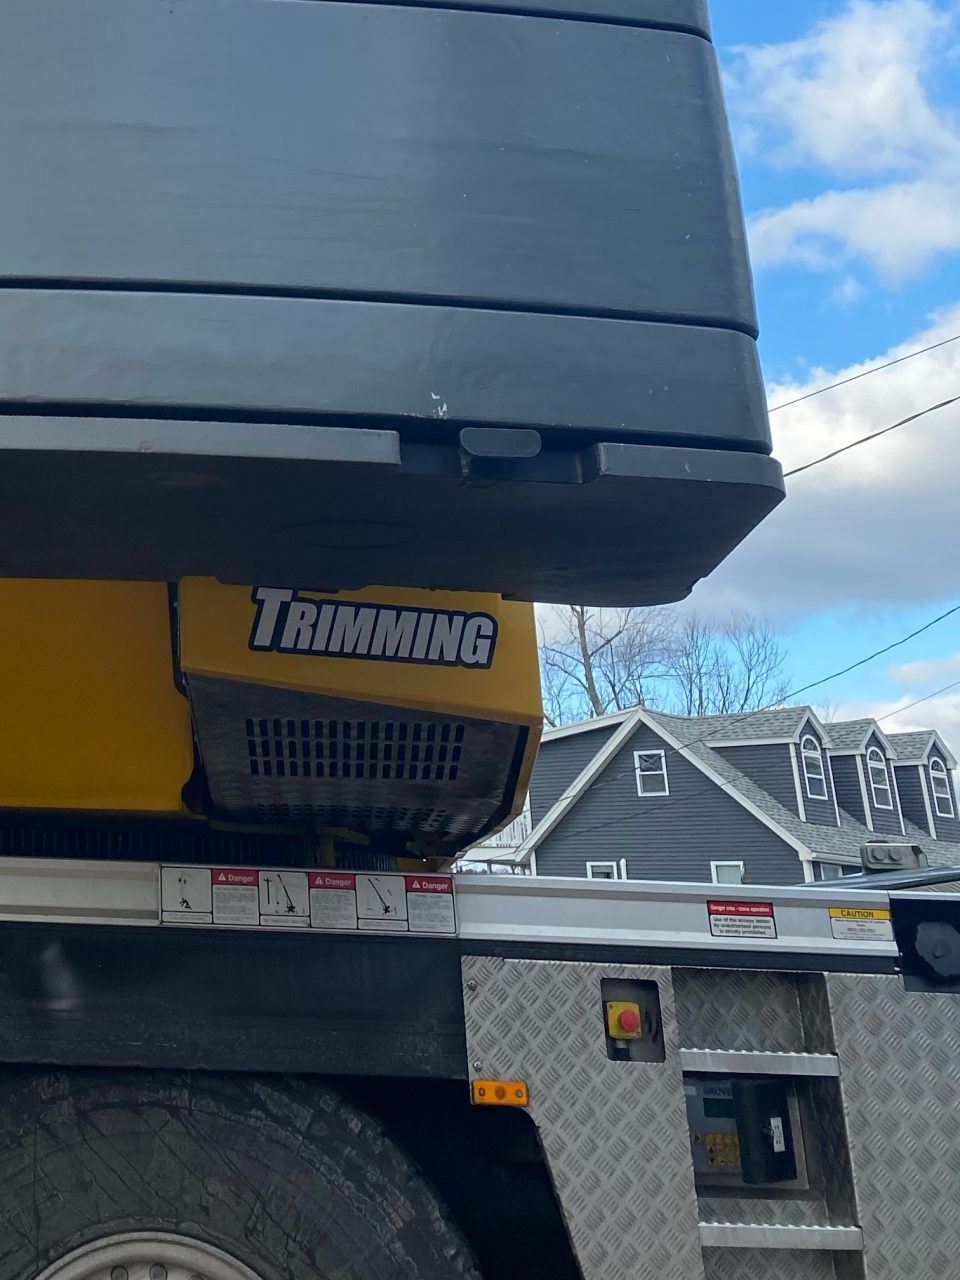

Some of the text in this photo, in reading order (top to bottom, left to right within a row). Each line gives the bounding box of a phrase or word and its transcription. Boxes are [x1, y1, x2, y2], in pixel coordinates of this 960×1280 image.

[251, 586, 496, 666] TRIMMING
[228, 874, 254, 883] Danger
[325, 877, 352, 887] Danger
[421, 881, 448, 891] Danger
[841, 910, 874, 918] CAUTION
